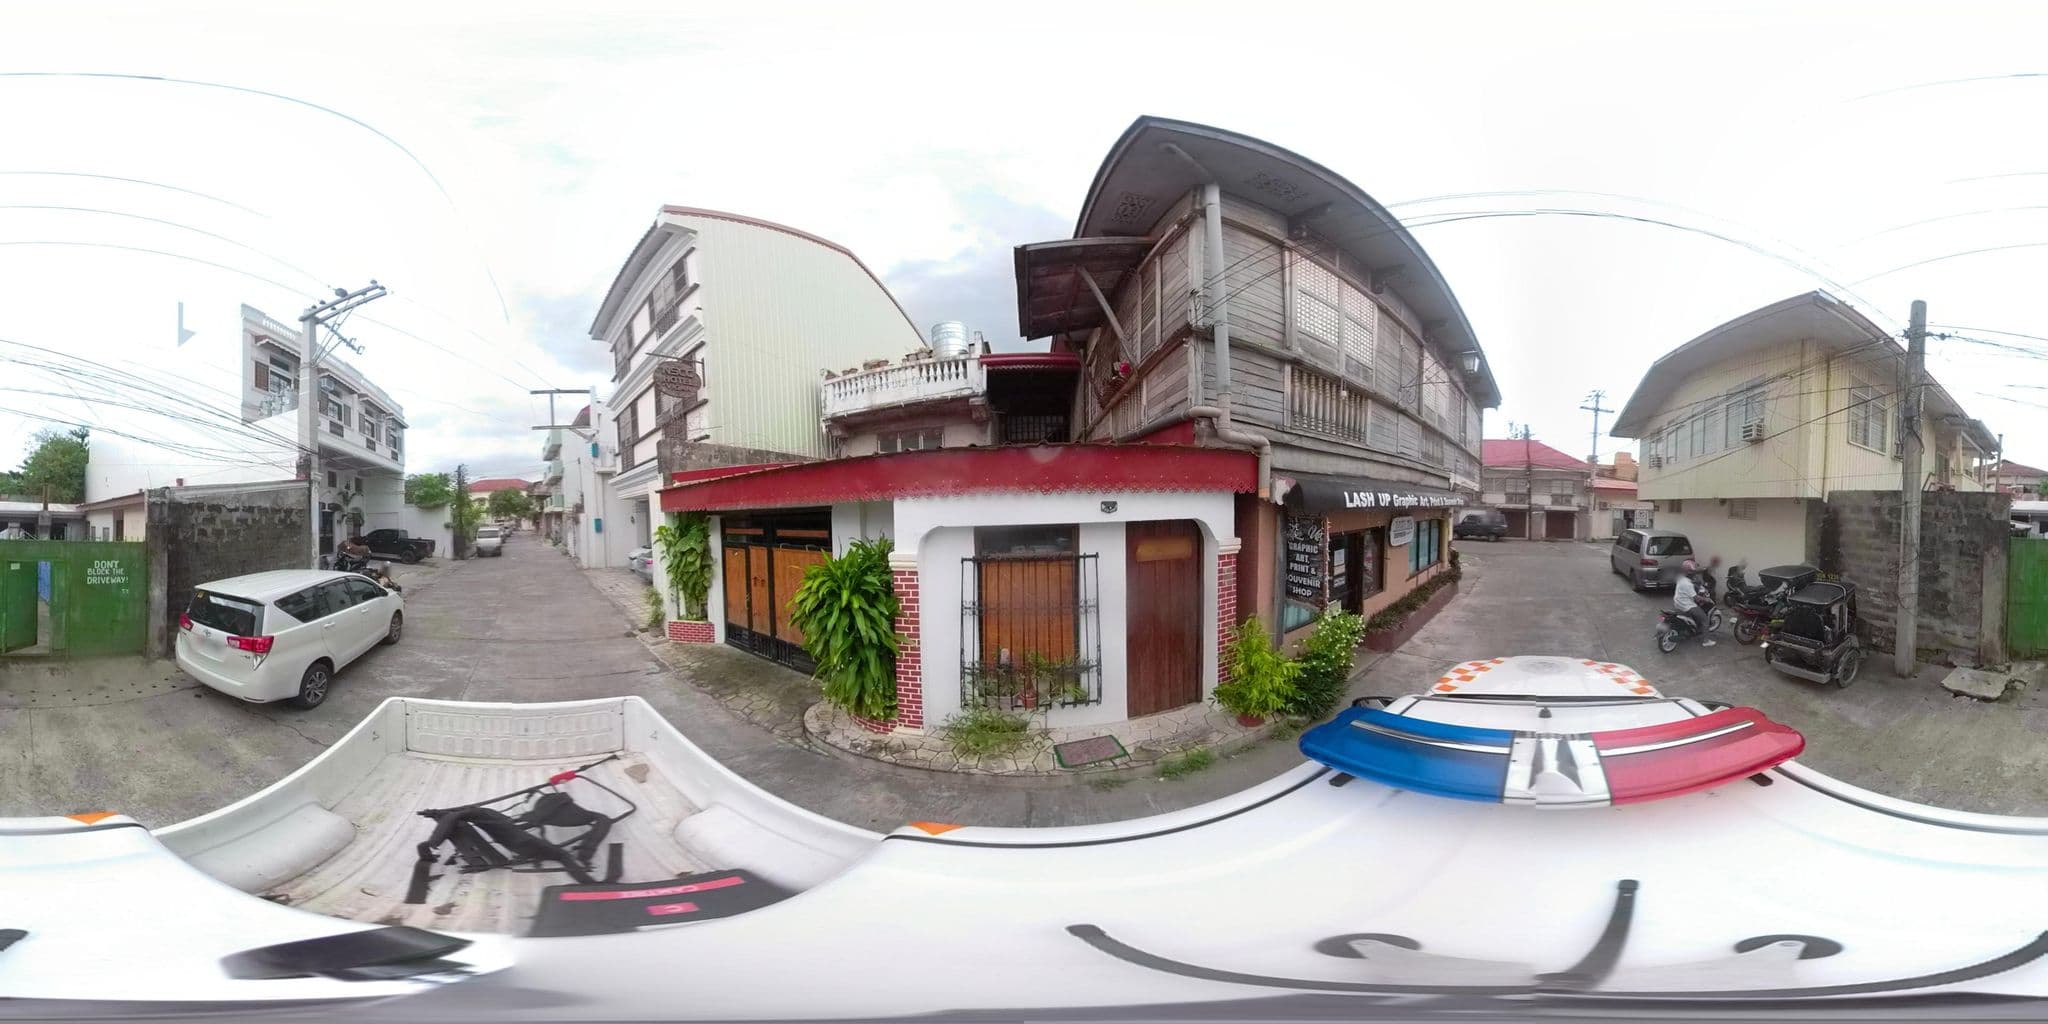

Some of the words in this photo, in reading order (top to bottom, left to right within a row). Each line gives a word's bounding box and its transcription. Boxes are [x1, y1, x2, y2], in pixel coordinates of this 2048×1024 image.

[663, 375, 697, 386] HOTEL
[1344, 491, 1375, 508] LASH
[1377, 492, 1391, 507] UP
[1393, 494, 1418, 509] Graphic
[87, 567, 111, 576] BLOCK
[1289, 562, 1309, 573] PRINT
[1310, 566, 1317, 575] &
